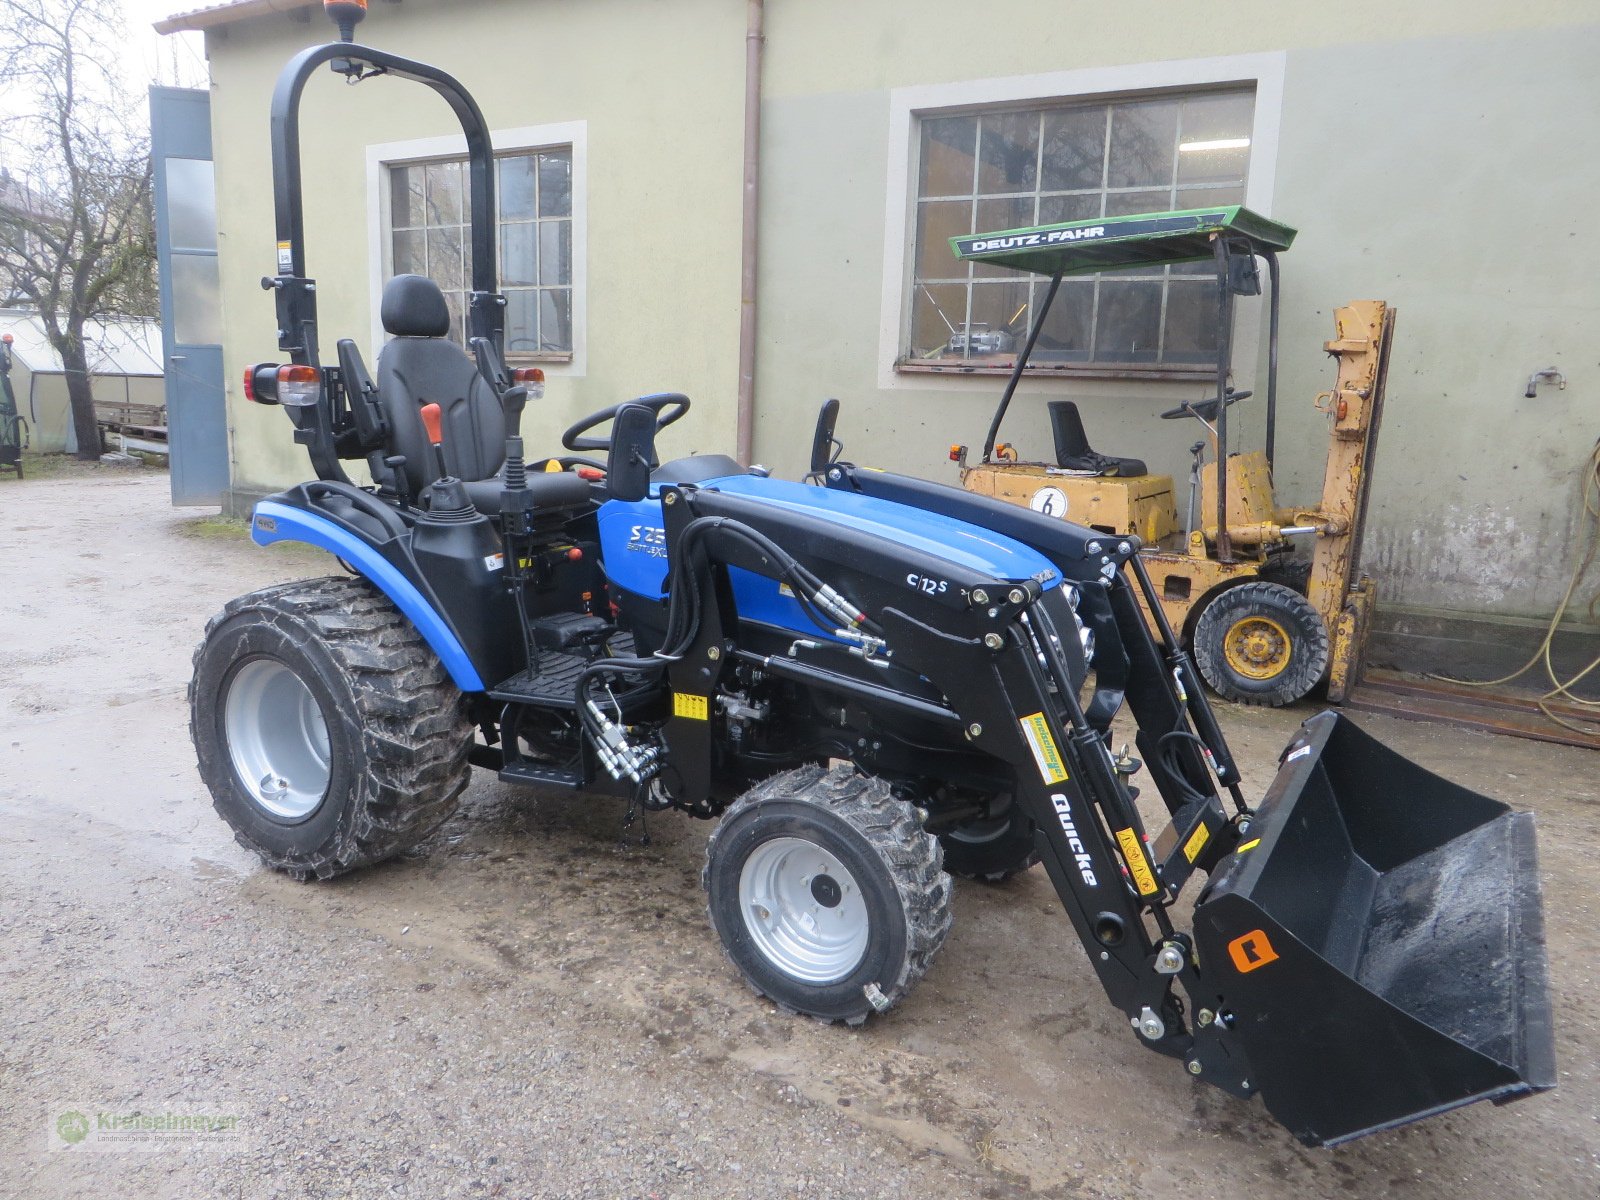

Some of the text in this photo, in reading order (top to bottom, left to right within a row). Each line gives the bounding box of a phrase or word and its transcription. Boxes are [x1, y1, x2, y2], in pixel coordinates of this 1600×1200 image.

[972, 226, 1105, 252] DEUTZ-FAHR
[1042, 493, 1053, 515] 6
[1050, 793, 1098, 887] Quicke
